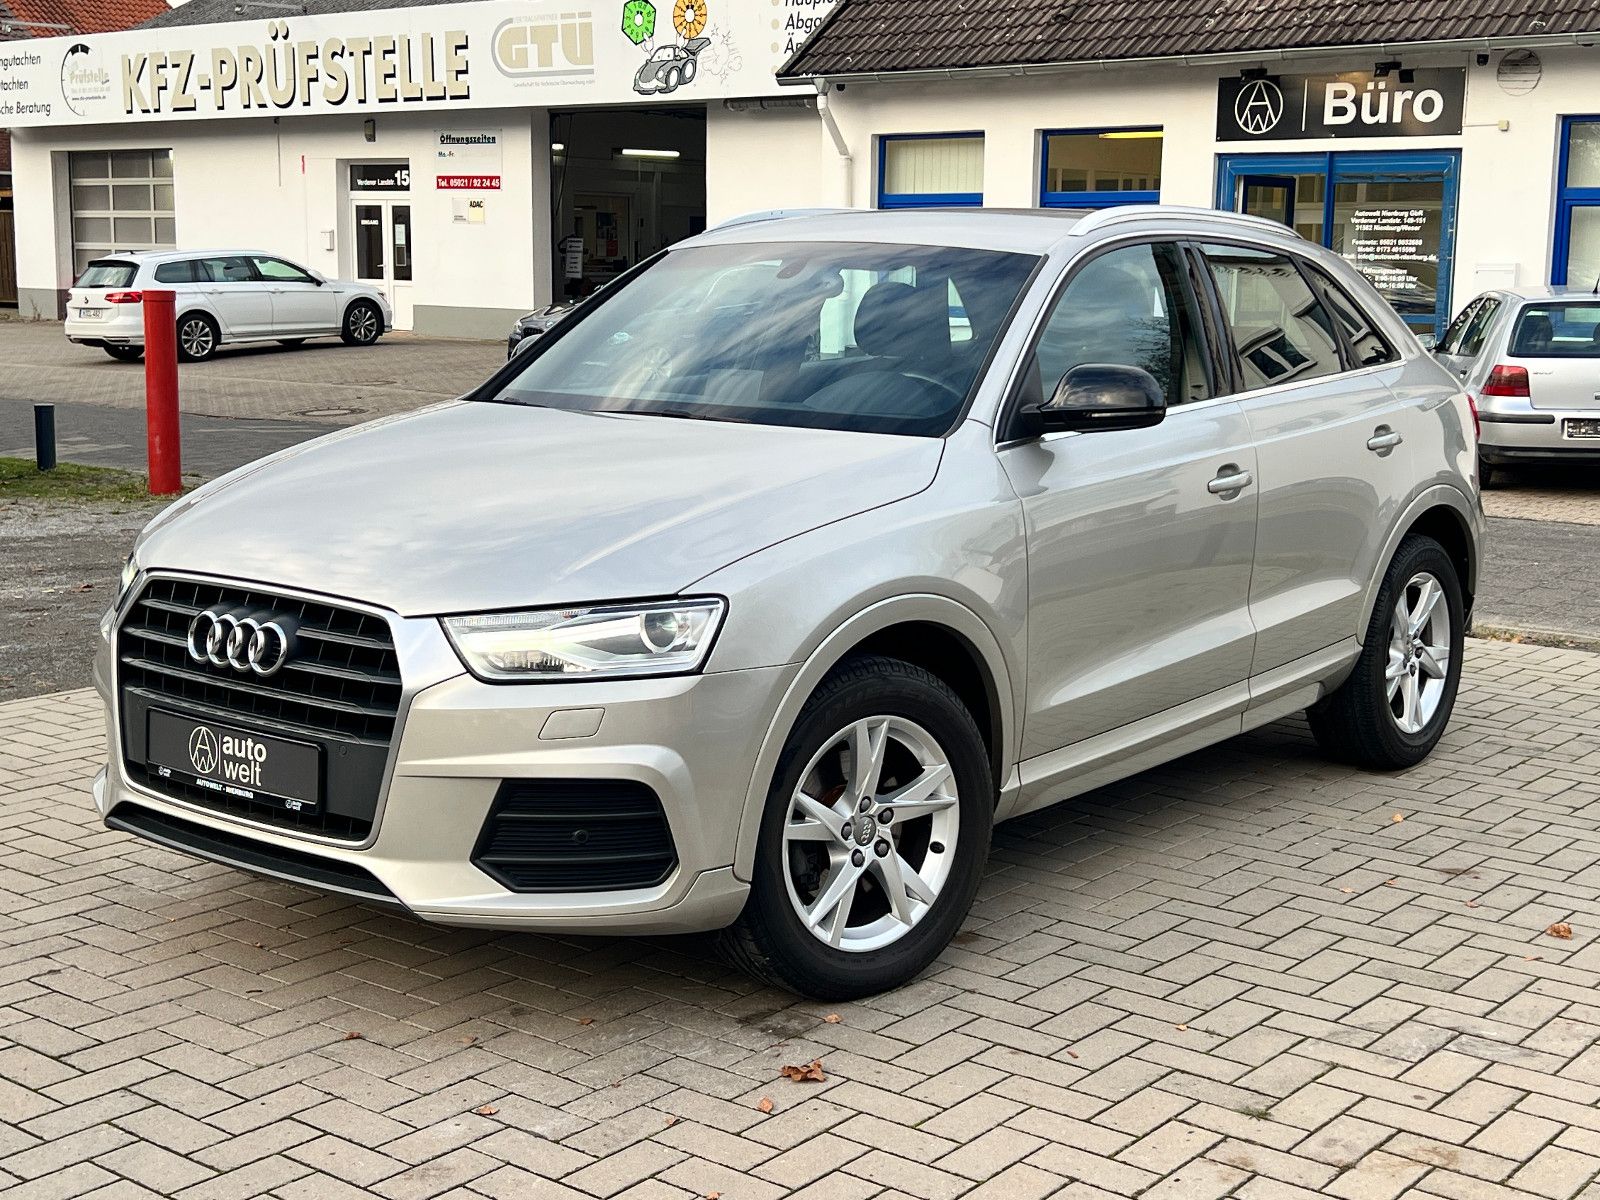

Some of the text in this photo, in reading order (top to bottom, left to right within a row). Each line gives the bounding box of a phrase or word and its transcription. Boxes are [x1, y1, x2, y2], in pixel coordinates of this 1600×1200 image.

[498, 12, 594, 68] GTÜ
[121, 20, 470, 114] KFZ-PRÜFSTELLE
[16, 102, 51, 116] Beratung
[1323, 81, 1444, 125] Büro
[440, 133, 496, 144] Öffnungszeiten
[395, 170, 410, 186] 15
[438, 179, 448, 187] Tel.
[482, 179, 490, 187] 24
[492, 179, 500, 187] 45
[222, 735, 267, 762] auto
[223, 760, 262, 786] welt
